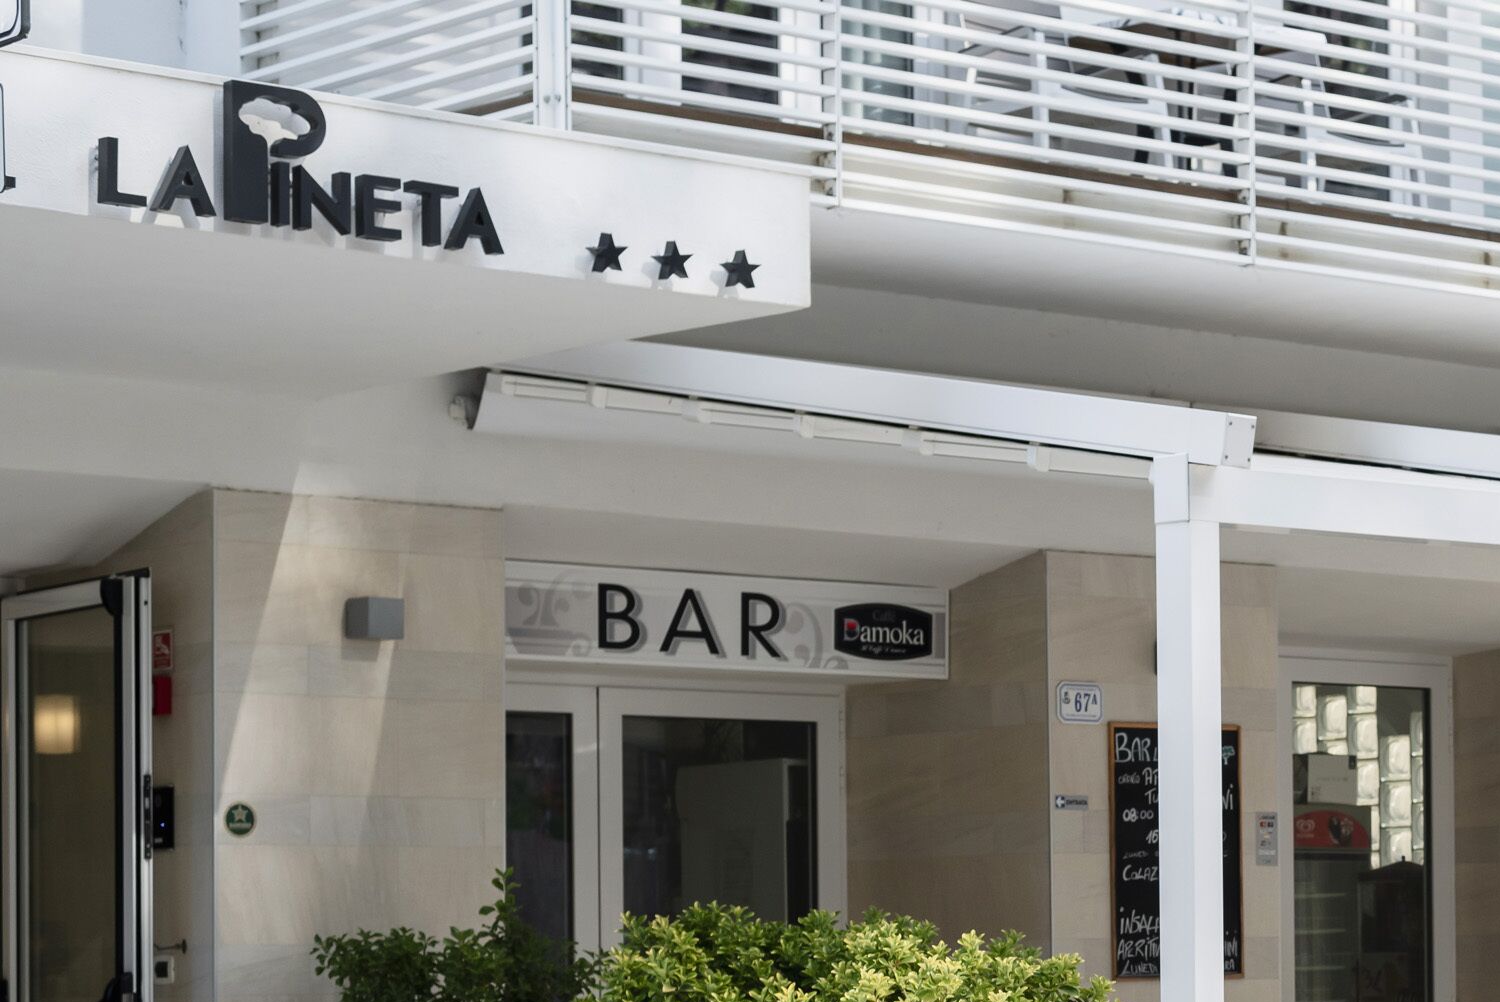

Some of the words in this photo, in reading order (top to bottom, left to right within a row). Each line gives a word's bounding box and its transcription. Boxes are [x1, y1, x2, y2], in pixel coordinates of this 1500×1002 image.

[97, 136, 217, 217] LA
[223, 80, 504, 255] PINETA
[598, 583, 785, 659] BAR
[843, 618, 924, 645] Damoka
